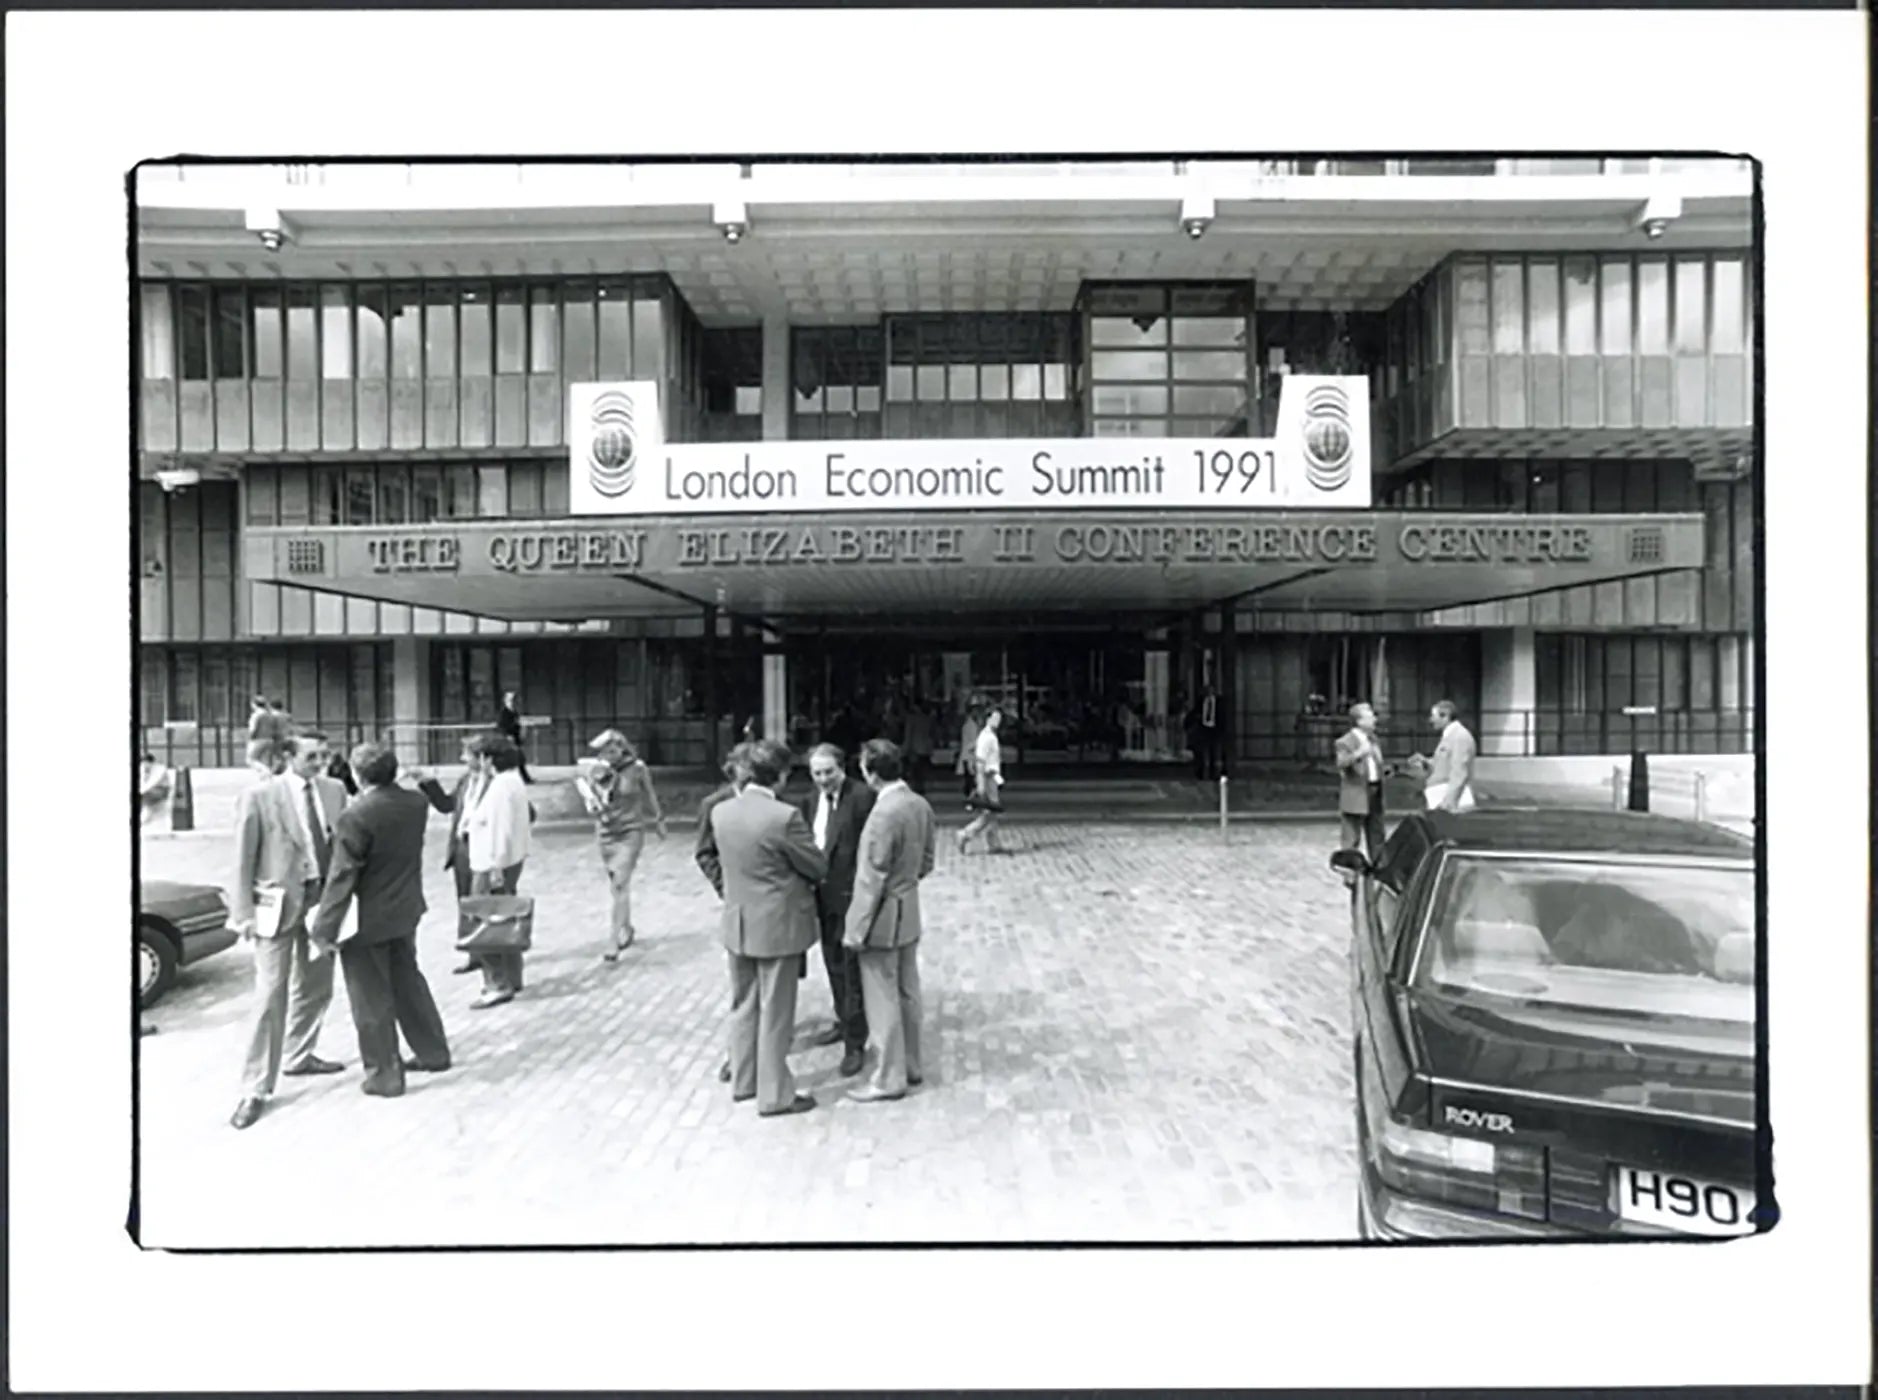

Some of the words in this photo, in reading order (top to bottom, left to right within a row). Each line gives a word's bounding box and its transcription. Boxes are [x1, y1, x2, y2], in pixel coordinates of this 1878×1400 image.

[665, 453, 797, 500] London
[826, 453, 1005, 497] Economic
[1031, 451, 1165, 496] Summit
[1193, 449, 1277, 495] 1991
[367, 536, 460, 573] THE
[488, 530, 647, 573] QUEEN
[677, 526, 964, 567] ELIZABETH
[992, 525, 1035, 562] II
[1054, 524, 1378, 563] CONFERENCE
[1400, 525, 1594, 563] CENTRE
[1444, 1105, 1516, 1134] ROVER
[1629, 1170, 1757, 1225] H90
